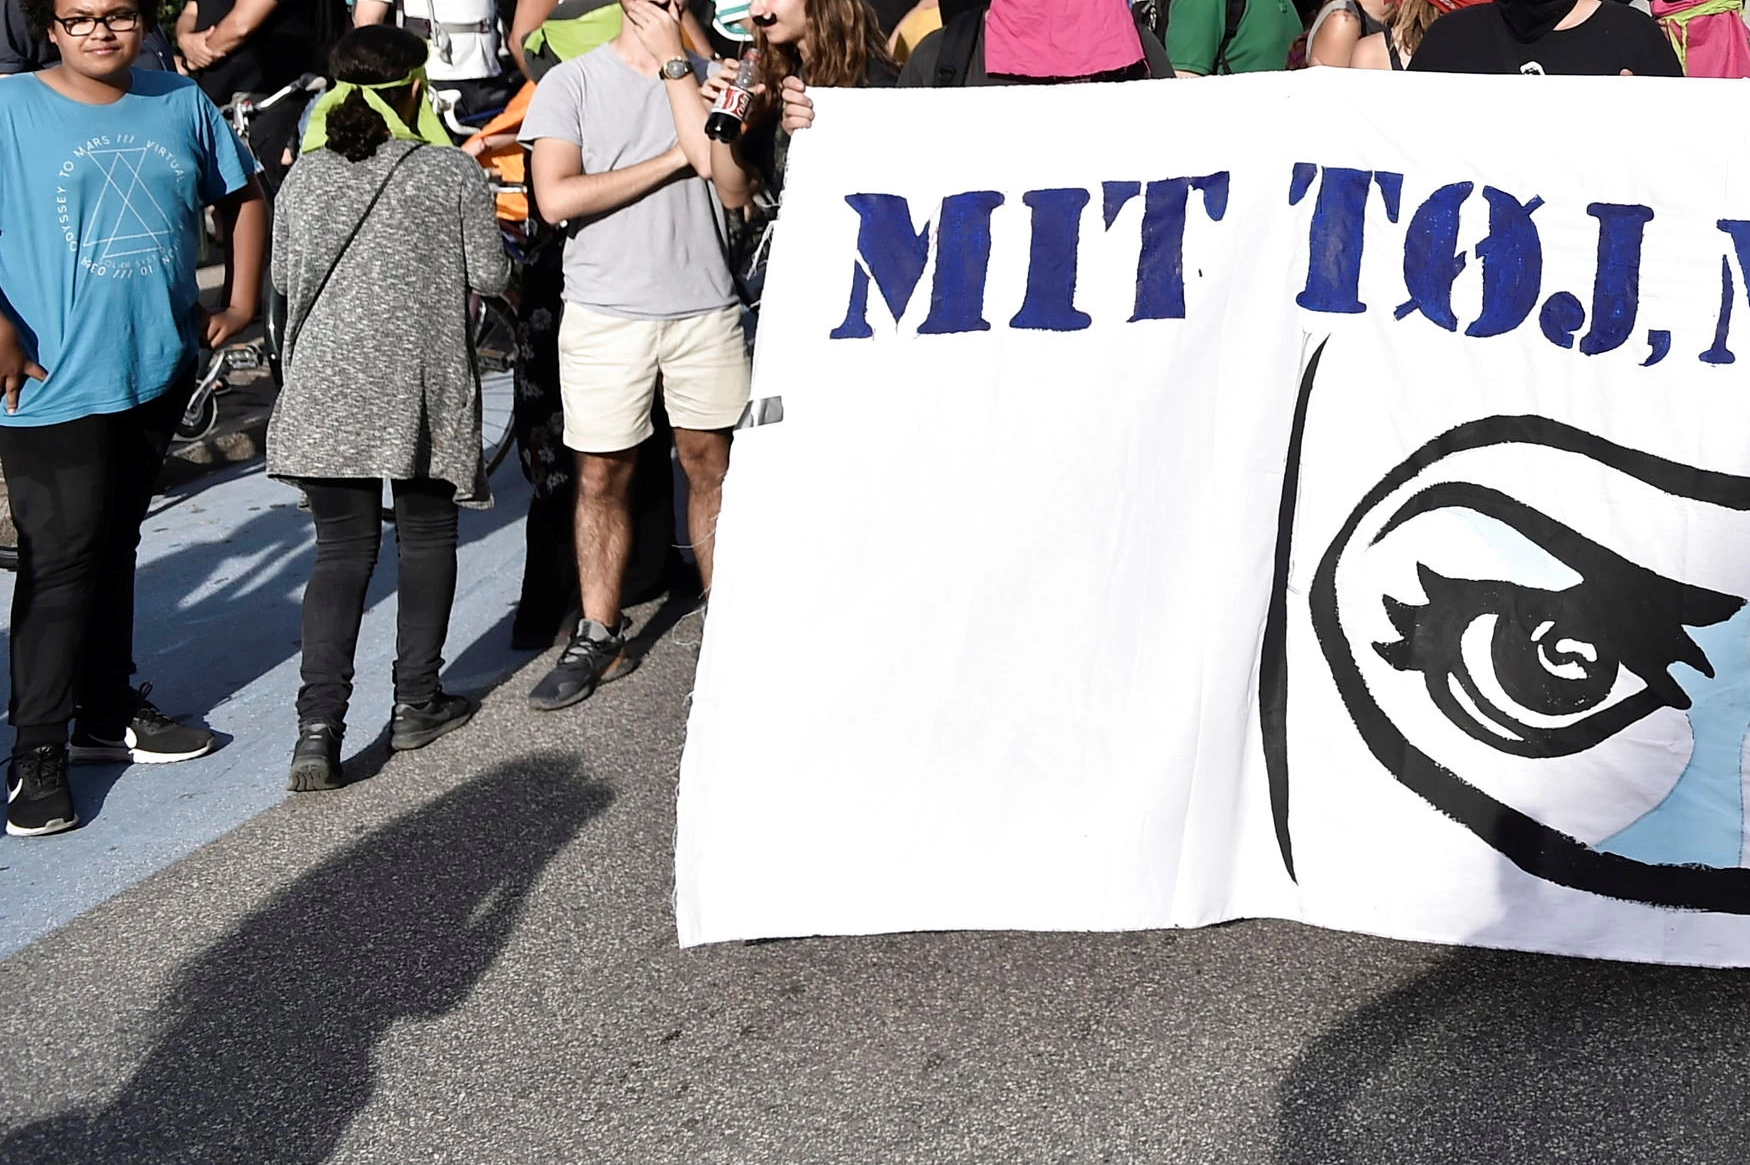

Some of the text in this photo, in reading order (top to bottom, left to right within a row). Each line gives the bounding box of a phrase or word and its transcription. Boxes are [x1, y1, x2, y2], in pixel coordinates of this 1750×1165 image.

[73, 135, 111, 158] MARS
[145, 140, 185, 182] VIRTUAL
[59, 161, 75, 178] TO
[56, 186, 79, 252] ODYSSEY
[830, 171, 1229, 339] MIT
[1289, 162, 1672, 368] TØJ,
